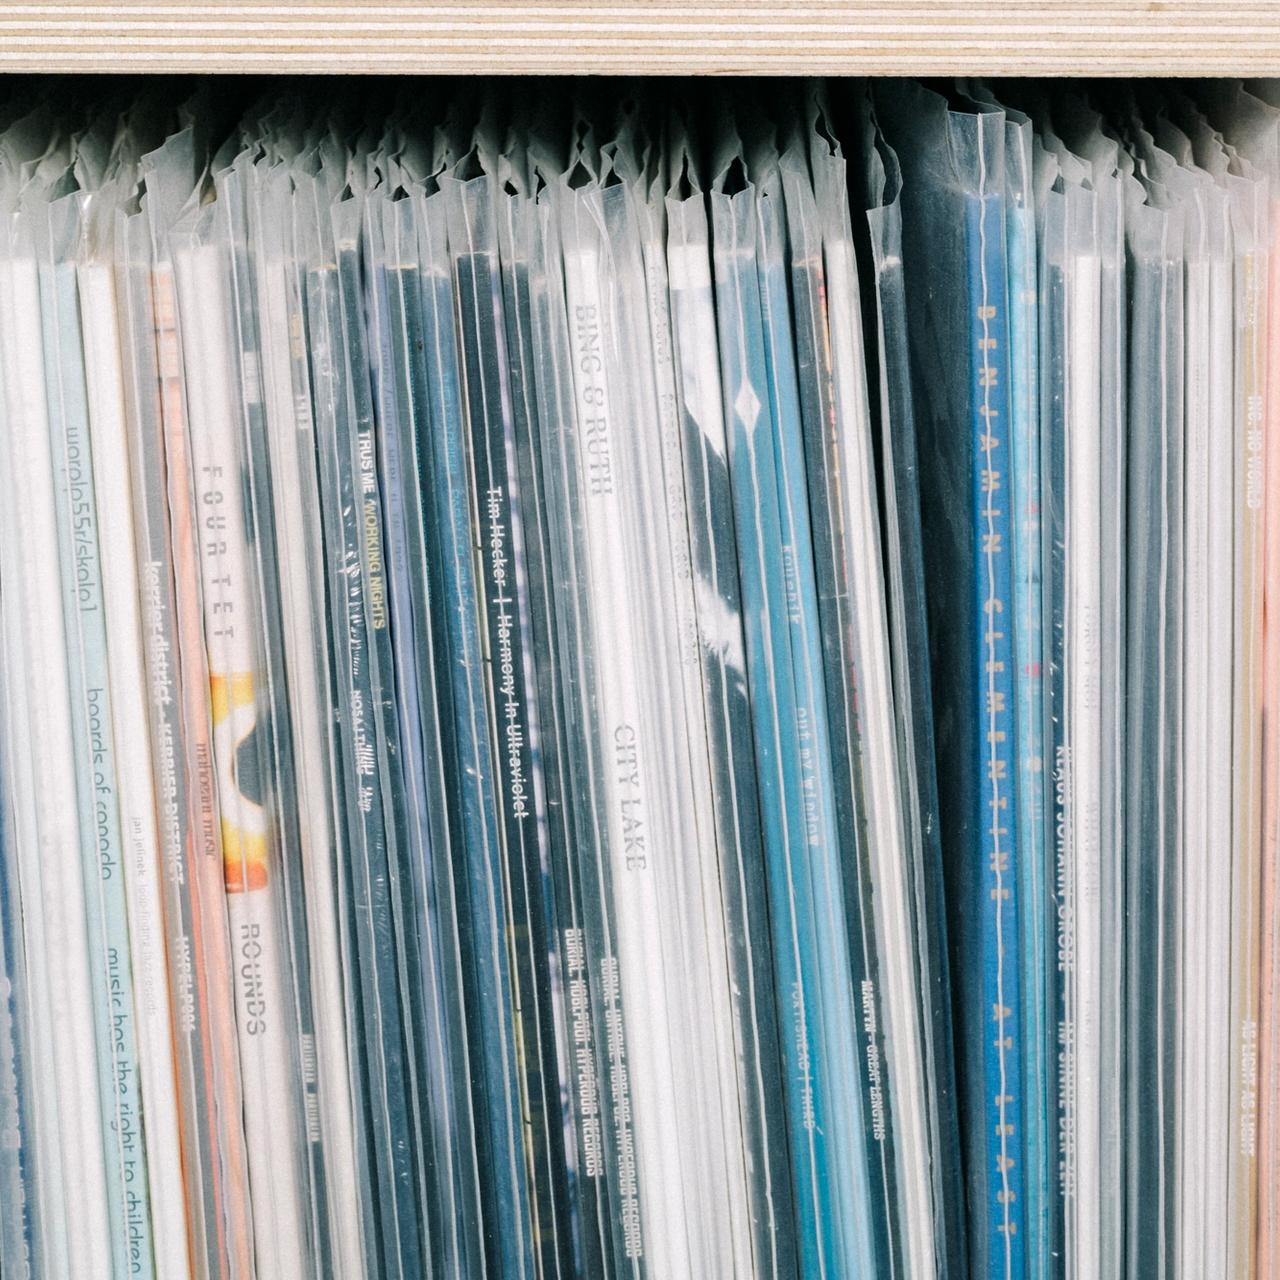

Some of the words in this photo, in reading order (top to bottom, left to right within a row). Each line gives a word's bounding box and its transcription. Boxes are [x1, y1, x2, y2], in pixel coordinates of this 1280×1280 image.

[574, 303, 601, 373] BING
[581, 386, 605, 408] &
[976, 305, 1002, 554] BENJAMIN
[584, 416, 613, 497] RUTH
[485, 486, 504, 519] Tim
[488, 523, 509, 588] Hecker
[493, 614, 518, 695] Harmony
[502, 702, 520, 719] In
[504, 723, 529, 819] Ultraviolet
[612, 724, 641, 790] CITY
[619, 799, 648, 872] LAKE
[239, 924, 267, 1038] ROUNDS
[859, 980, 878, 1034] MARTYN
[112, 1059, 132, 1094] the
[865, 1044, 882, 1085] GREAT
[867, 1086, 886, 1142] LENGTHS
[121, 1161, 137, 1182] to
